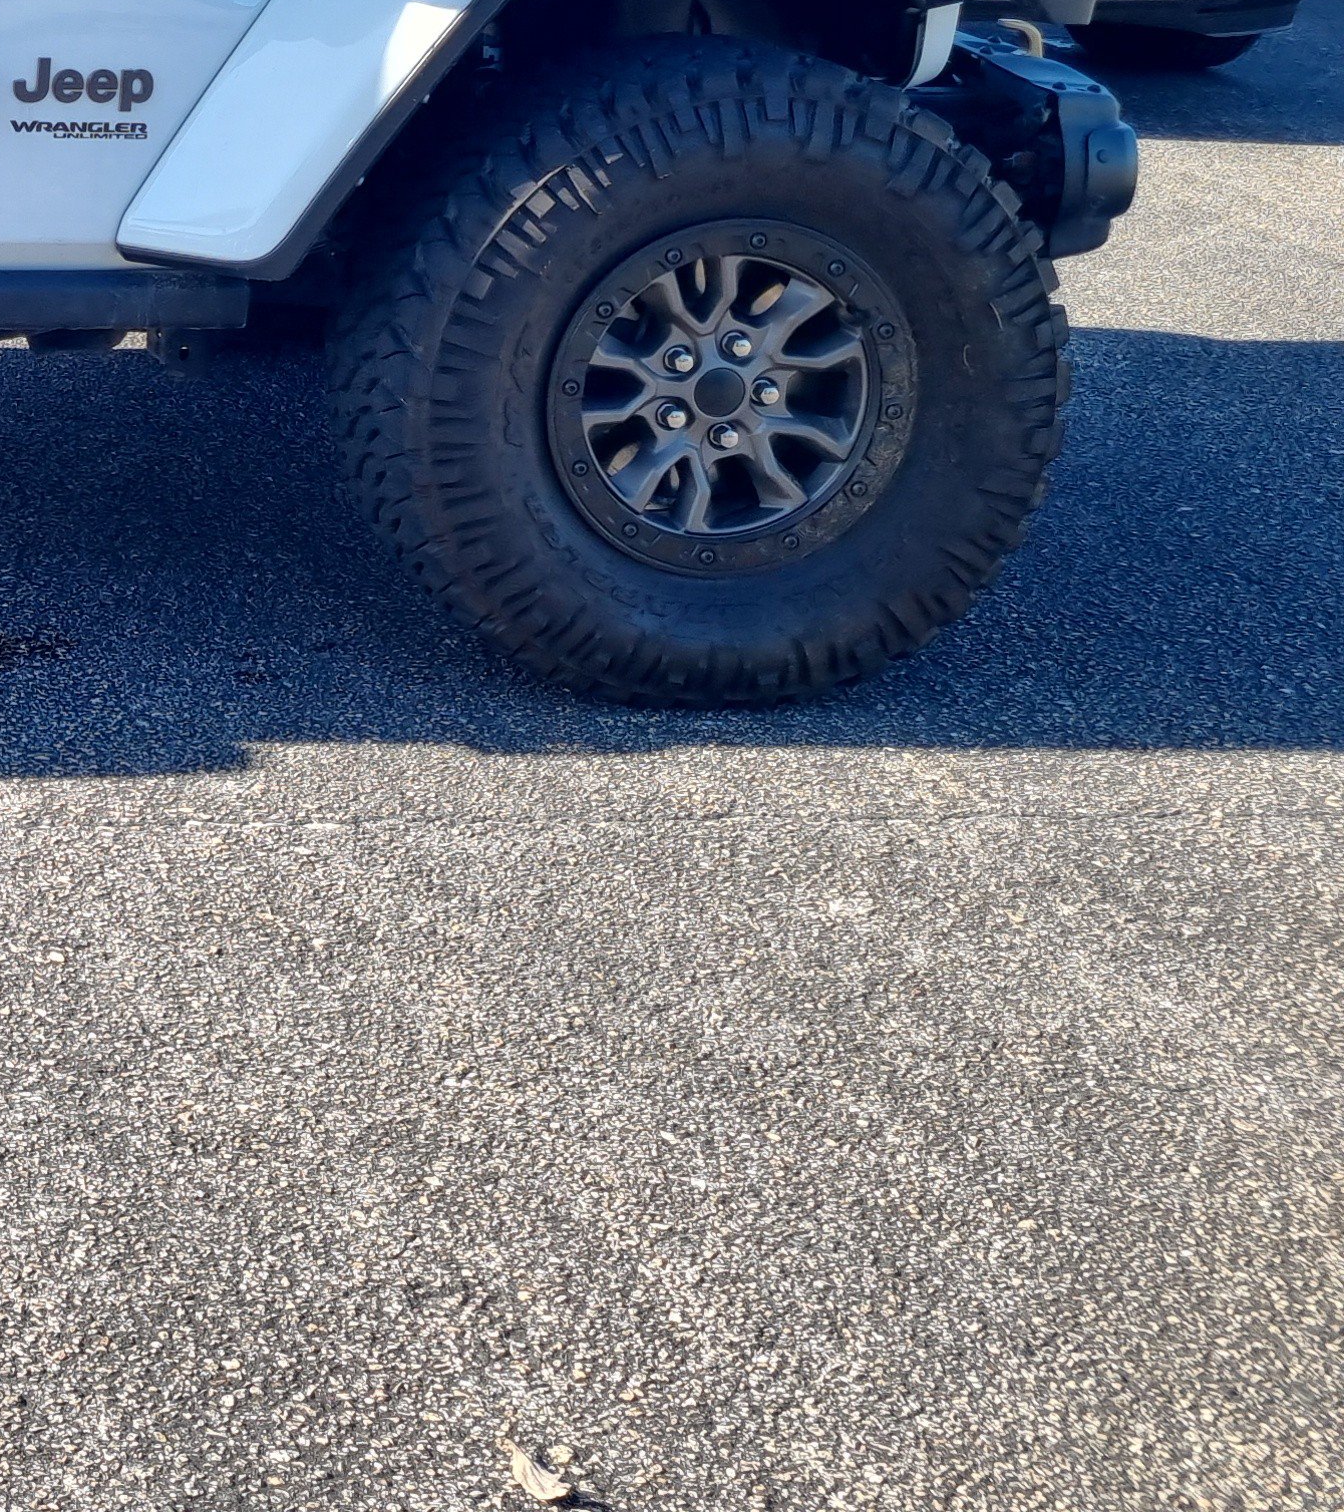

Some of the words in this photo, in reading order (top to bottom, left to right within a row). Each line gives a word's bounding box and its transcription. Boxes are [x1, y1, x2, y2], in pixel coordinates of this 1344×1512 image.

[12, 57, 154, 112] Jeep
[10, 120, 148, 134] WRANGLER
[53, 132, 148, 140] UNLIMITED
